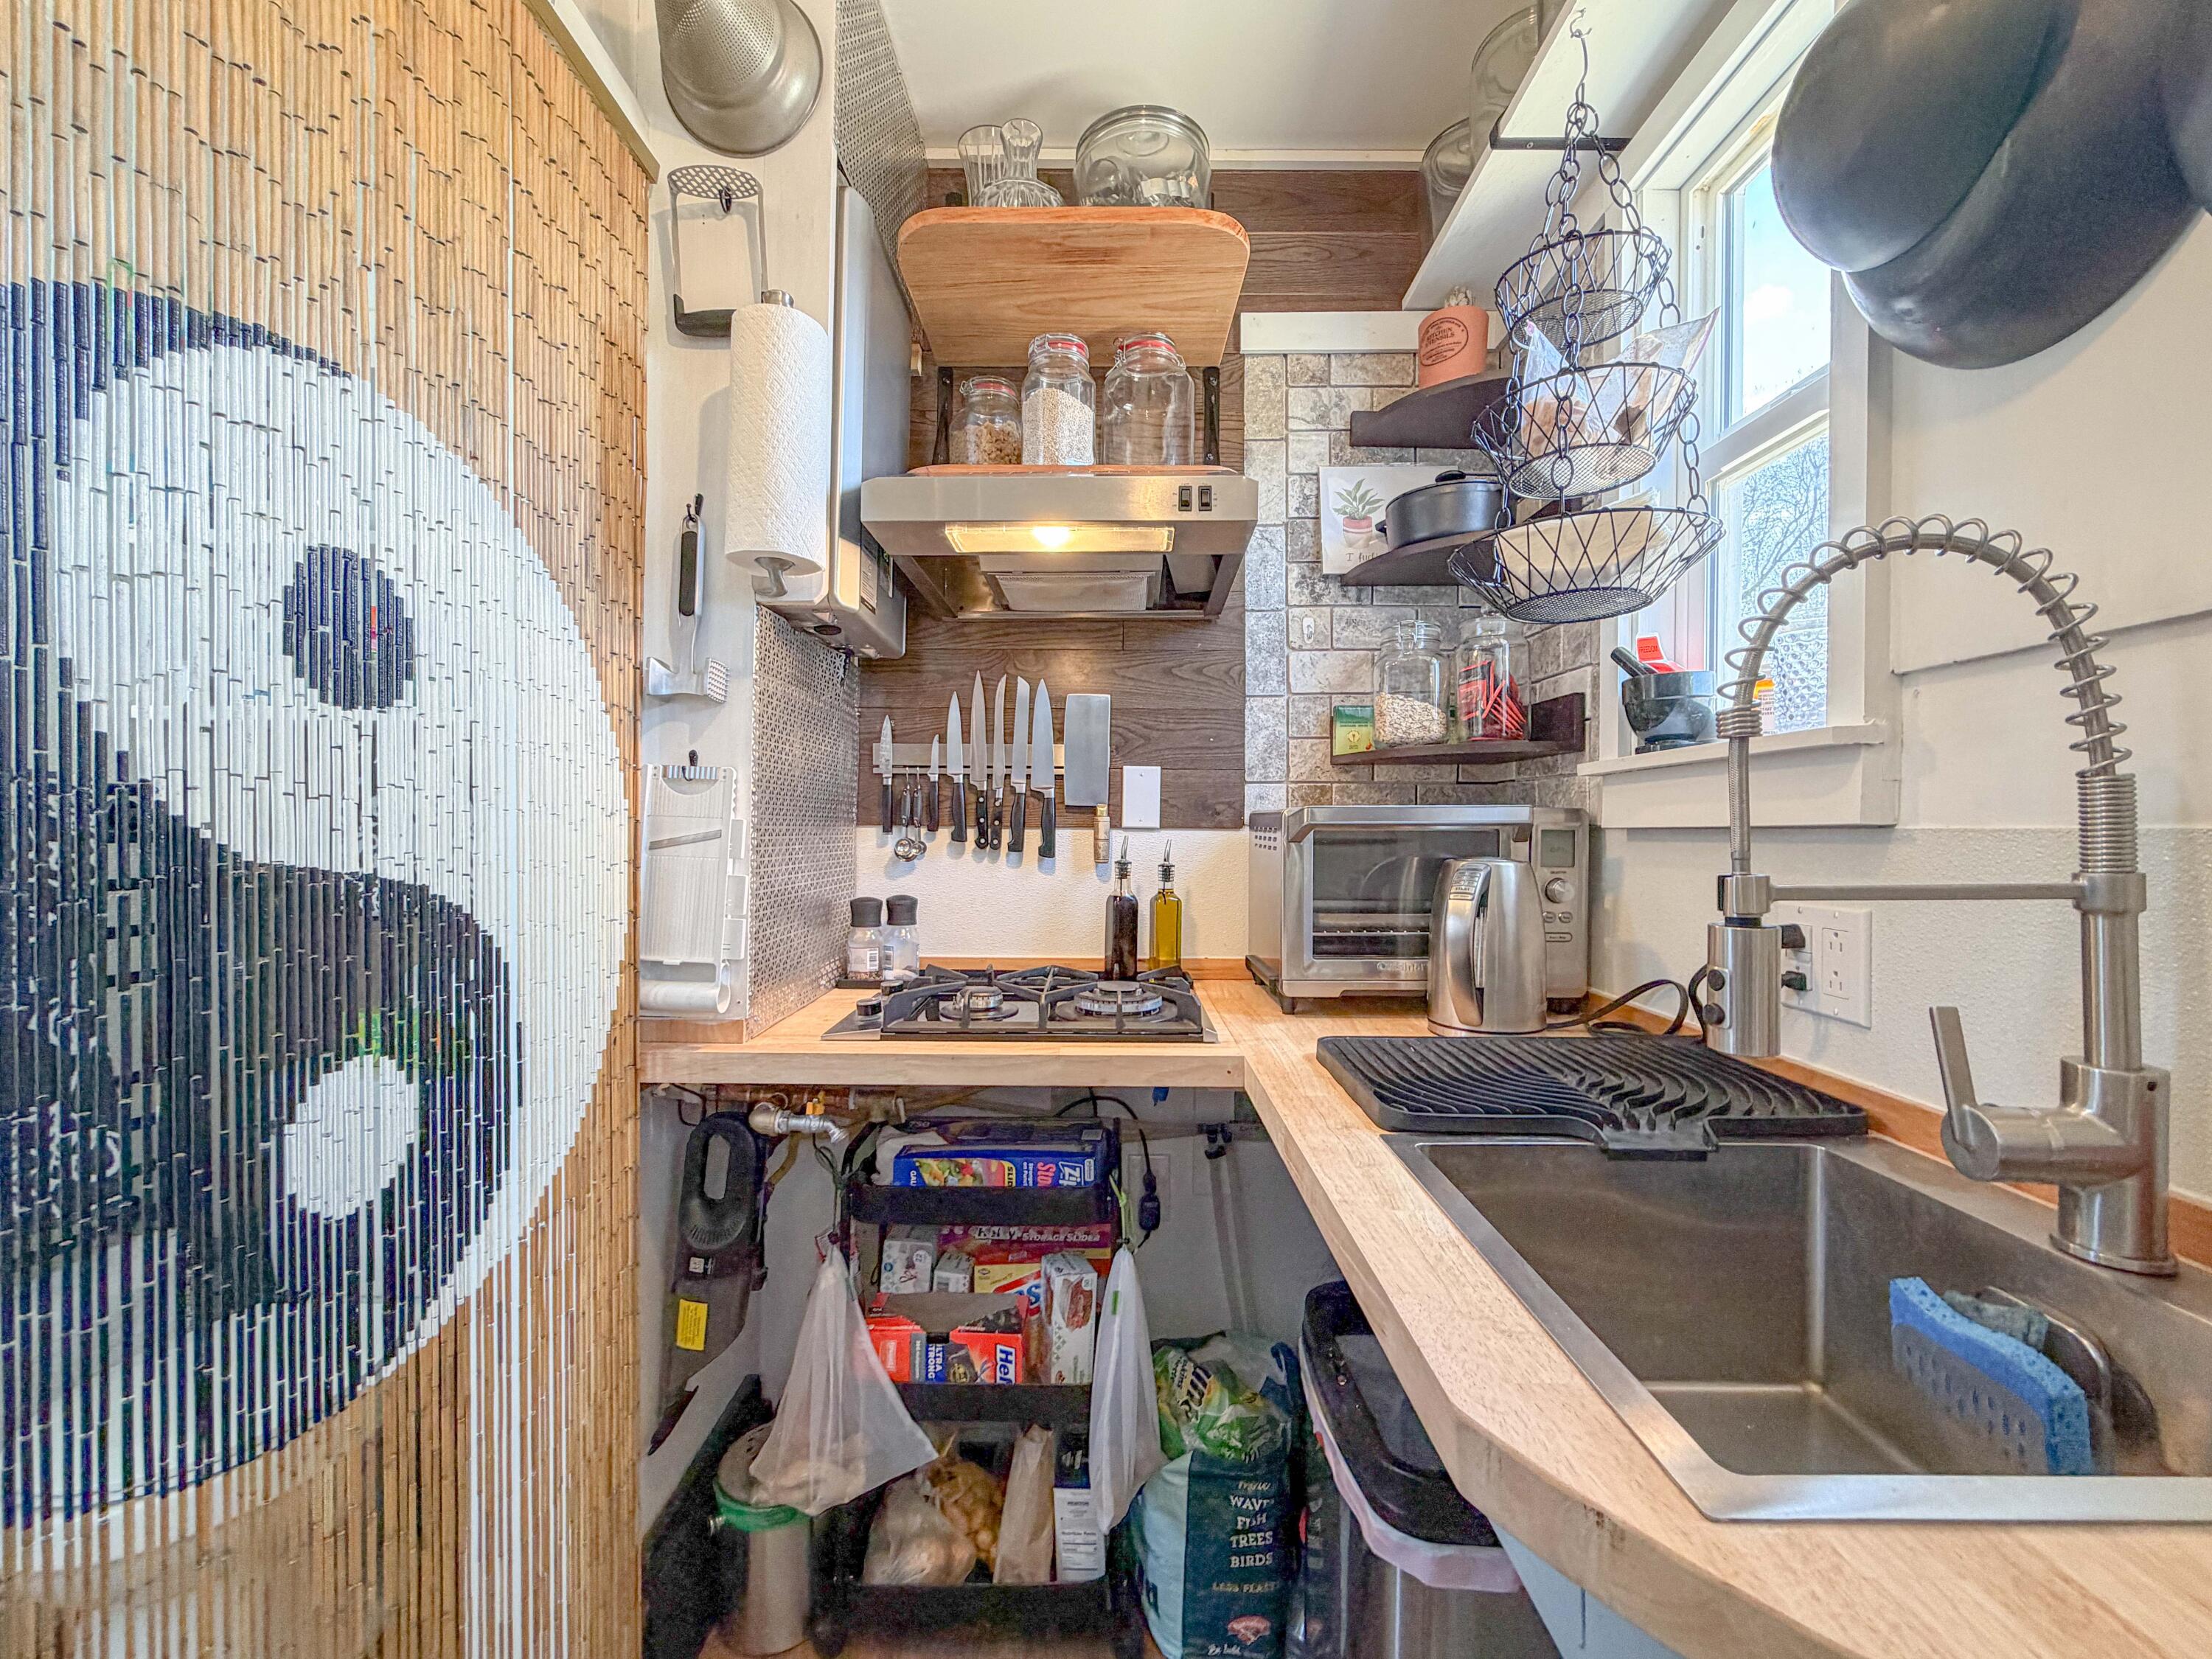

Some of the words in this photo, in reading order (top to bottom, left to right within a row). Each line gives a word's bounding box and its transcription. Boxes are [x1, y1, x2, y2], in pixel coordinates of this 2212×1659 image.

[1345, 552, 1354, 562] I
[1230, 1531, 1273, 1548] TREES
[1229, 1552, 1273, 1568] BIRDS
